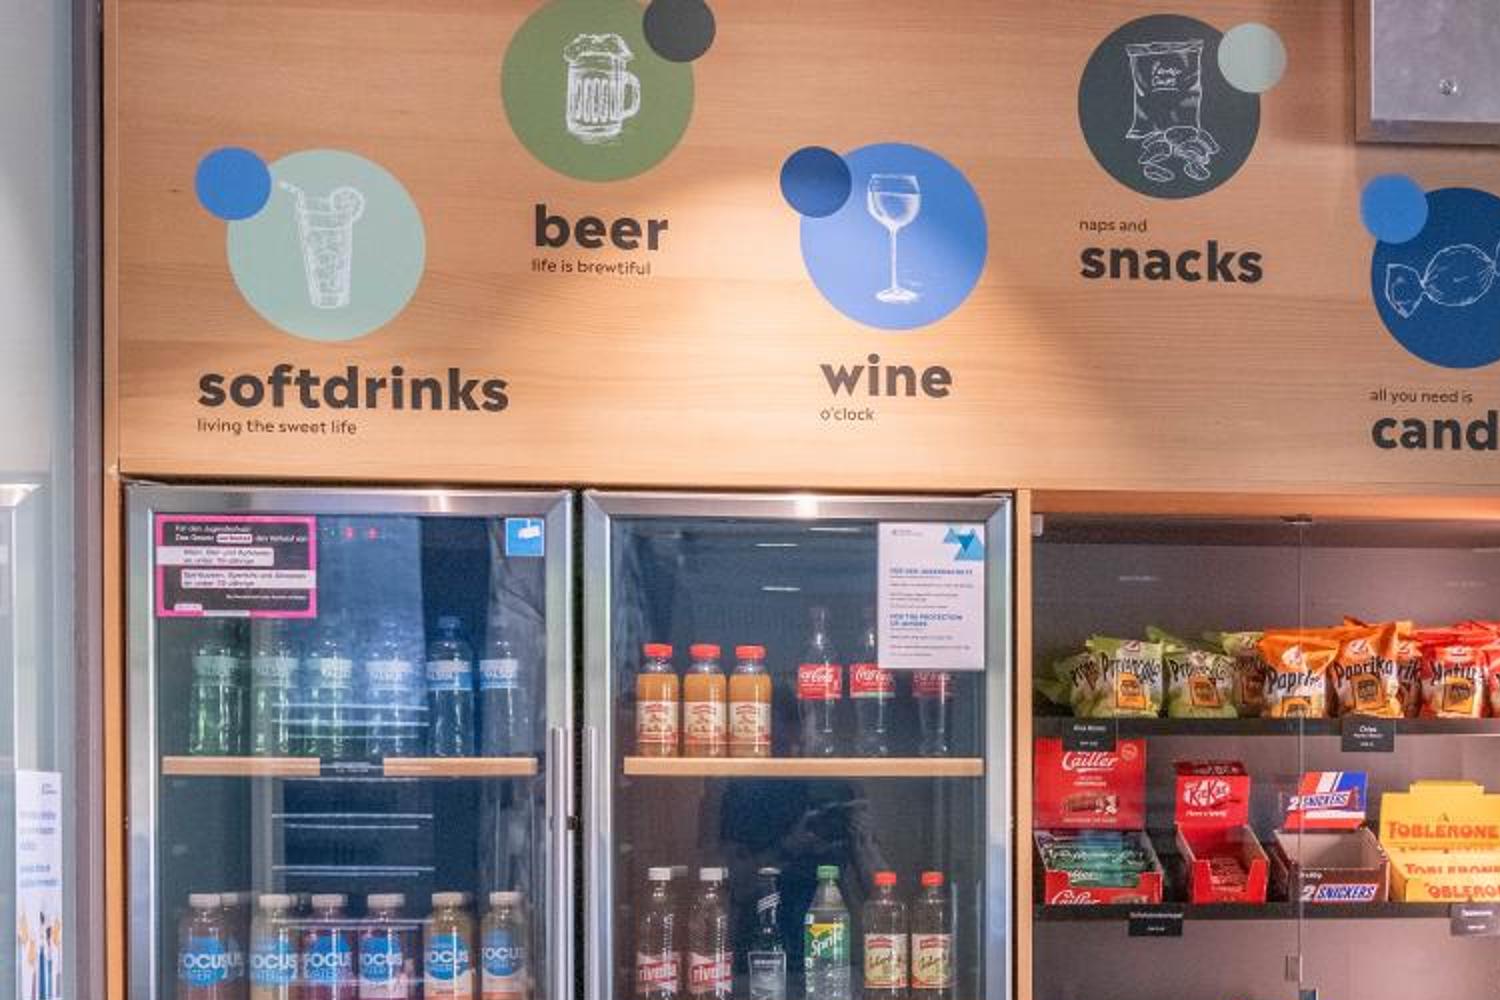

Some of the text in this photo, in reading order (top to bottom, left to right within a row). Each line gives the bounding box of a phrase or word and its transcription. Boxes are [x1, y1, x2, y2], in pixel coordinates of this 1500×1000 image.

[535, 203, 669, 251] beer
[1079, 219, 1148, 234] naps and
[531, 258, 651, 276] life is brewtiful
[1079, 240, 1263, 284] snacks
[820, 353, 953, 399] wine
[197, 363, 509, 413] softdrinks
[1370, 388, 1473, 405] all you need is
[819, 407, 875, 421] o'clock
[197, 418, 357, 436] living the sweet life
[1331, 655, 1394, 689] Paprika
[1061, 751, 1120, 773] Cailler
[1388, 820, 1500, 840] TOBLERONE
[1317, 885, 1376, 899] SNICKERS
